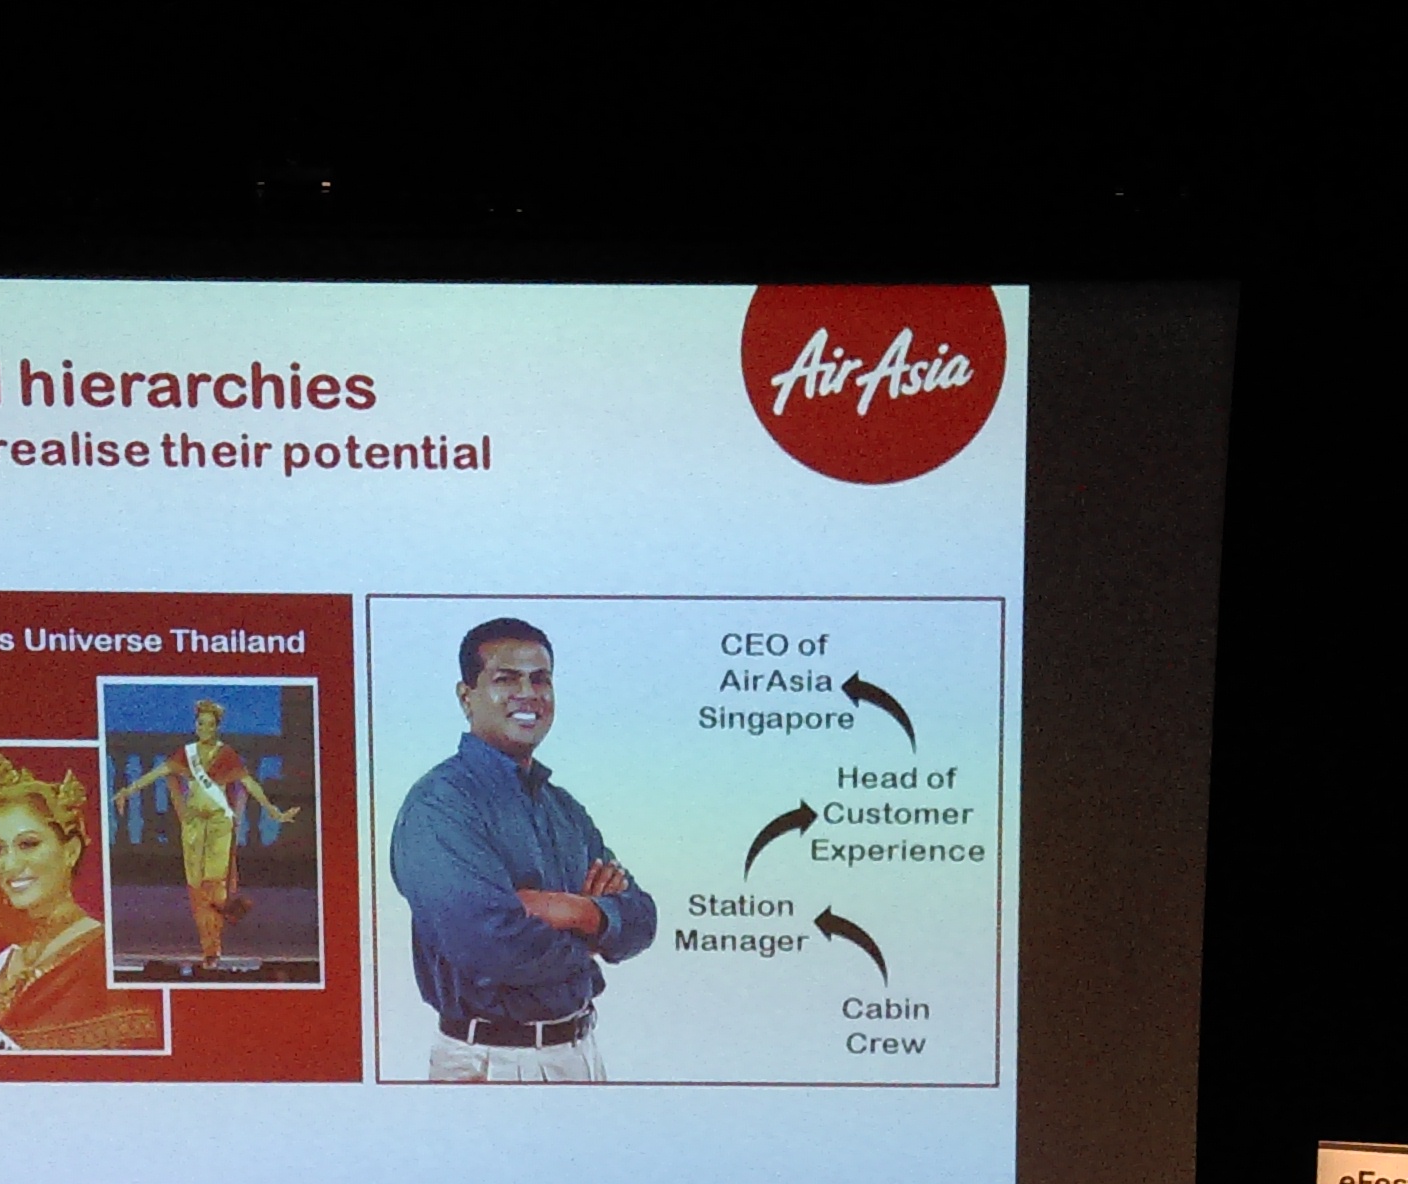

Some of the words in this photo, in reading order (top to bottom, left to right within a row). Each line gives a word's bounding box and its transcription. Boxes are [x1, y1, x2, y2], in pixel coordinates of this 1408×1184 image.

[20, 357, 377, 411] hierarchies
[161, 432, 272, 468] their
[284, 434, 491, 477] potential
[25, 627, 163, 653] Universe
[169, 629, 305, 654] Thailand
[721, 633, 789, 657] CEO
[797, 633, 830, 657] of
[719, 670, 833, 692] AirAsia
[698, 706, 855, 736] Singapore
[838, 767, 918, 789] Head
[926, 767, 958, 789] of
[823, 802, 974, 825] Customer
[811, 839, 986, 867] Experience
[688, 894, 794, 917] Station
[675, 930, 810, 958] Manager
[842, 998, 930, 1020] Cabin
[846, 1033, 927, 1055] Crew
